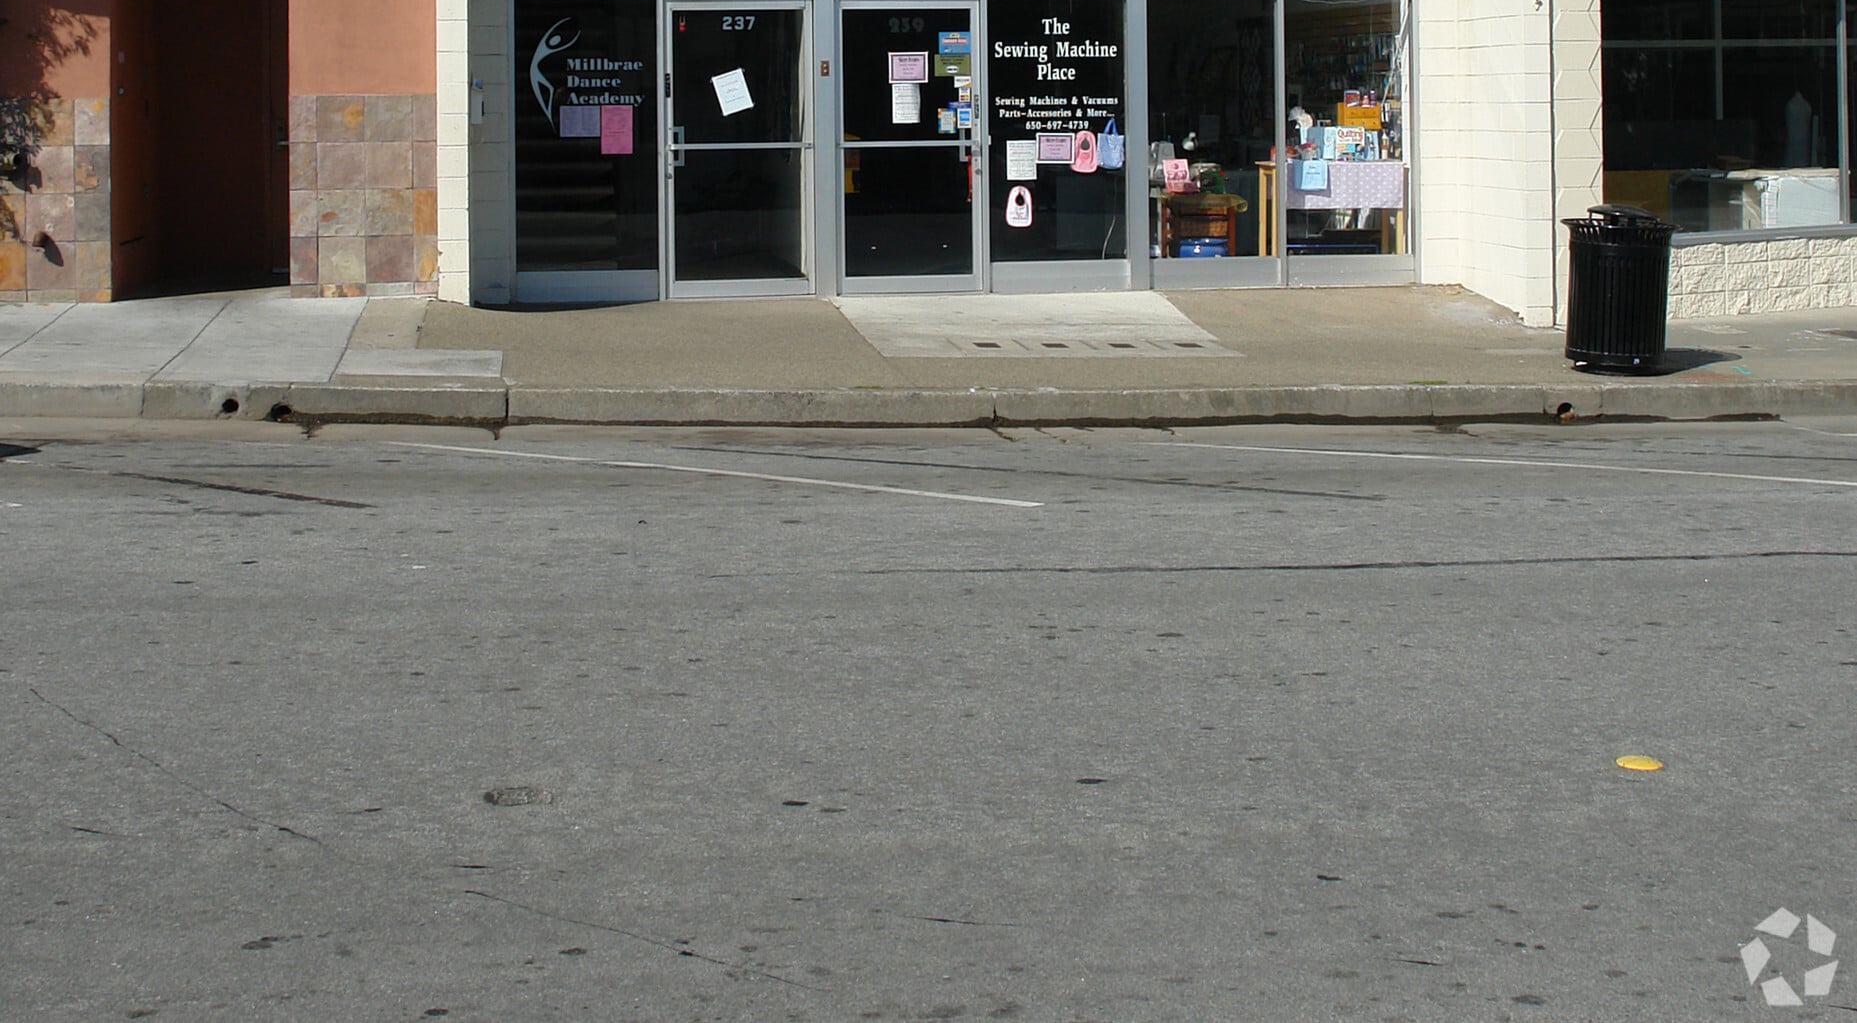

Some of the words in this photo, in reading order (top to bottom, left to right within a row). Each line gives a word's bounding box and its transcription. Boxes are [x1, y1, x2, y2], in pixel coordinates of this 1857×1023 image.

[722, 16, 756, 31] 237
[1041, 17, 1071, 35] The
[994, 41, 1048, 63] Sewing
[1056, 39, 1118, 58] Machine
[566, 58, 643, 71] Millbrae
[1037, 62, 1076, 81] Place
[567, 75, 622, 88] Dance
[567, 91, 645, 108] Academy
[995, 96, 1026, 108] Sewing
[1029, 96, 1068, 106] Machines
[1071, 96, 1079, 106] &
[1082, 96, 1119, 106] Vacuums
[1075, 108, 1083, 118] &
[1025, 120, 1090, 131] 650-697-4739
